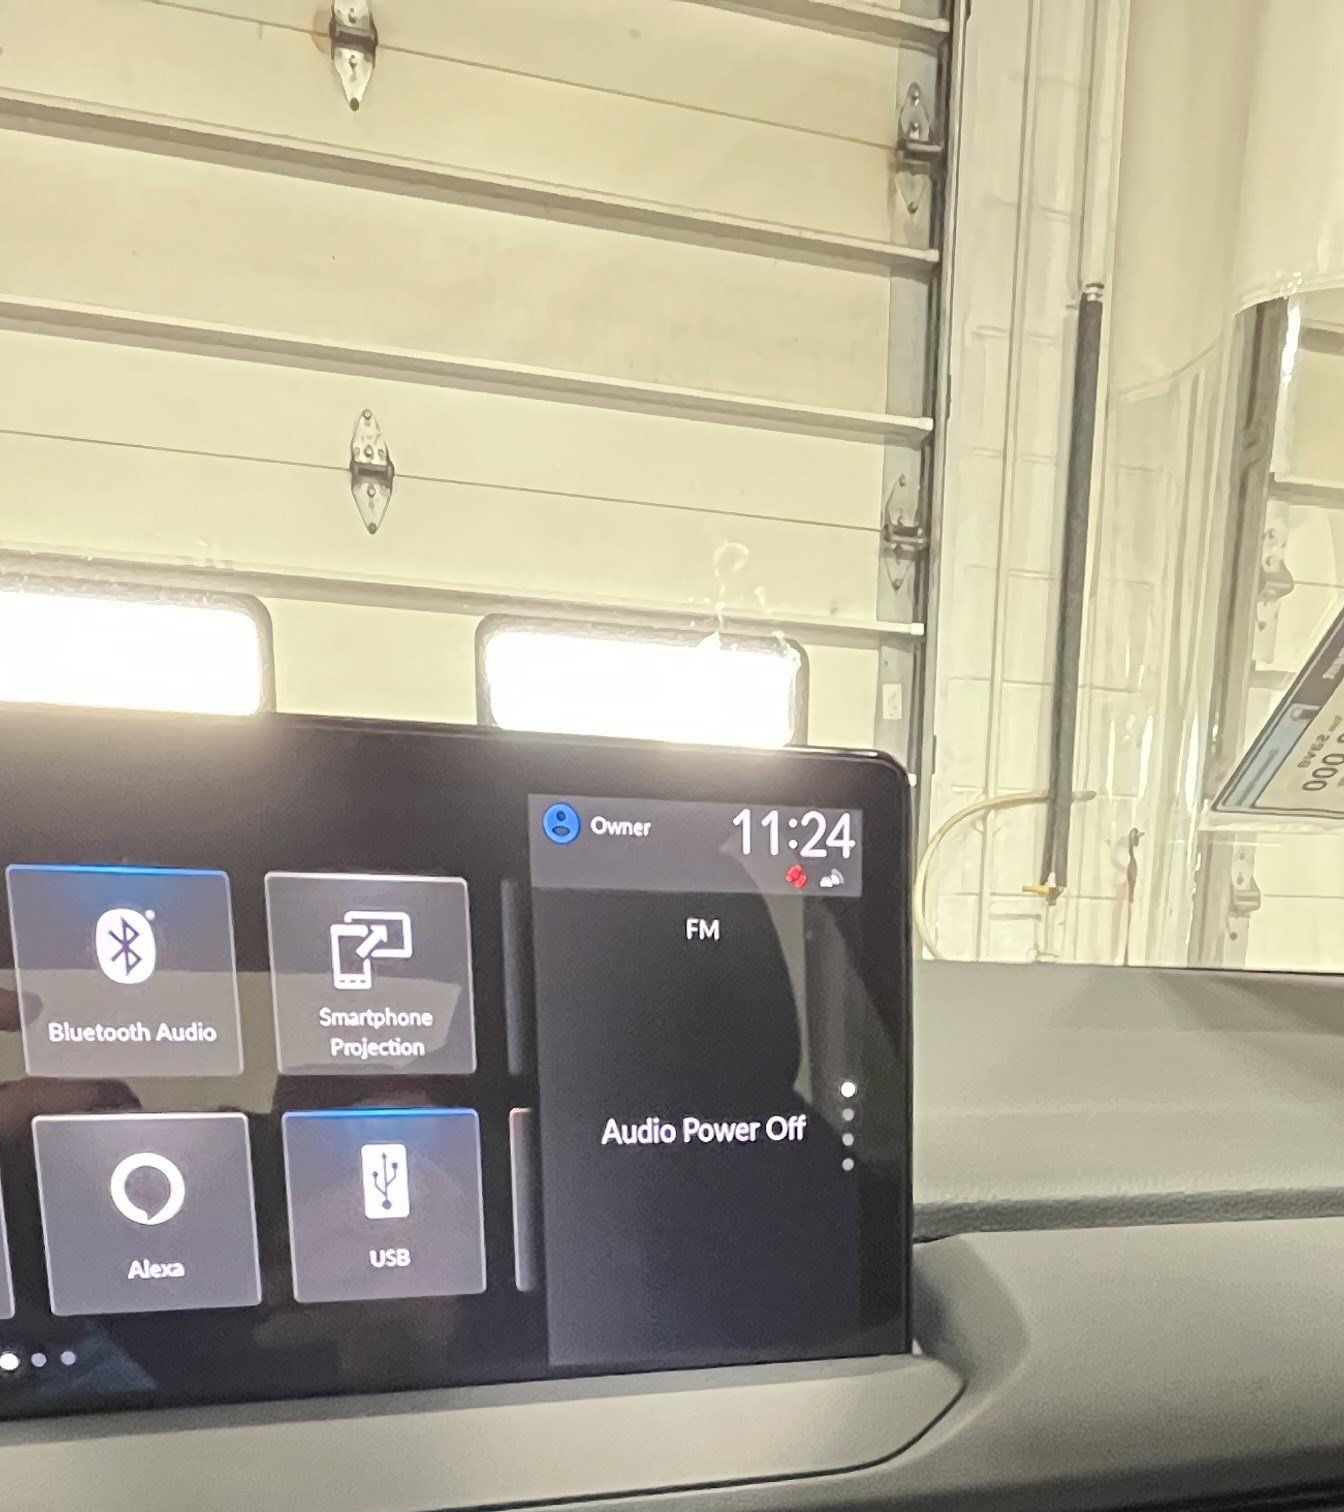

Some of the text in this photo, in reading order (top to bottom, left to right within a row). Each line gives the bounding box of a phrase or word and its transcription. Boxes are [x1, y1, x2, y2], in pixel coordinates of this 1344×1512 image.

[590, 816, 652, 838] Owner
[732, 808, 857, 860] 11:24
[685, 918, 721, 941] FM
[318, 1007, 434, 1032] Smartphone
[48, 1021, 217, 1043] Bluetooth Audio
[330, 1037, 425, 1060] Projection
[600, 1114, 808, 1146] Audio Power Off
[127, 1258, 186, 1280] Alexa
[369, 1247, 411, 1268] USB
